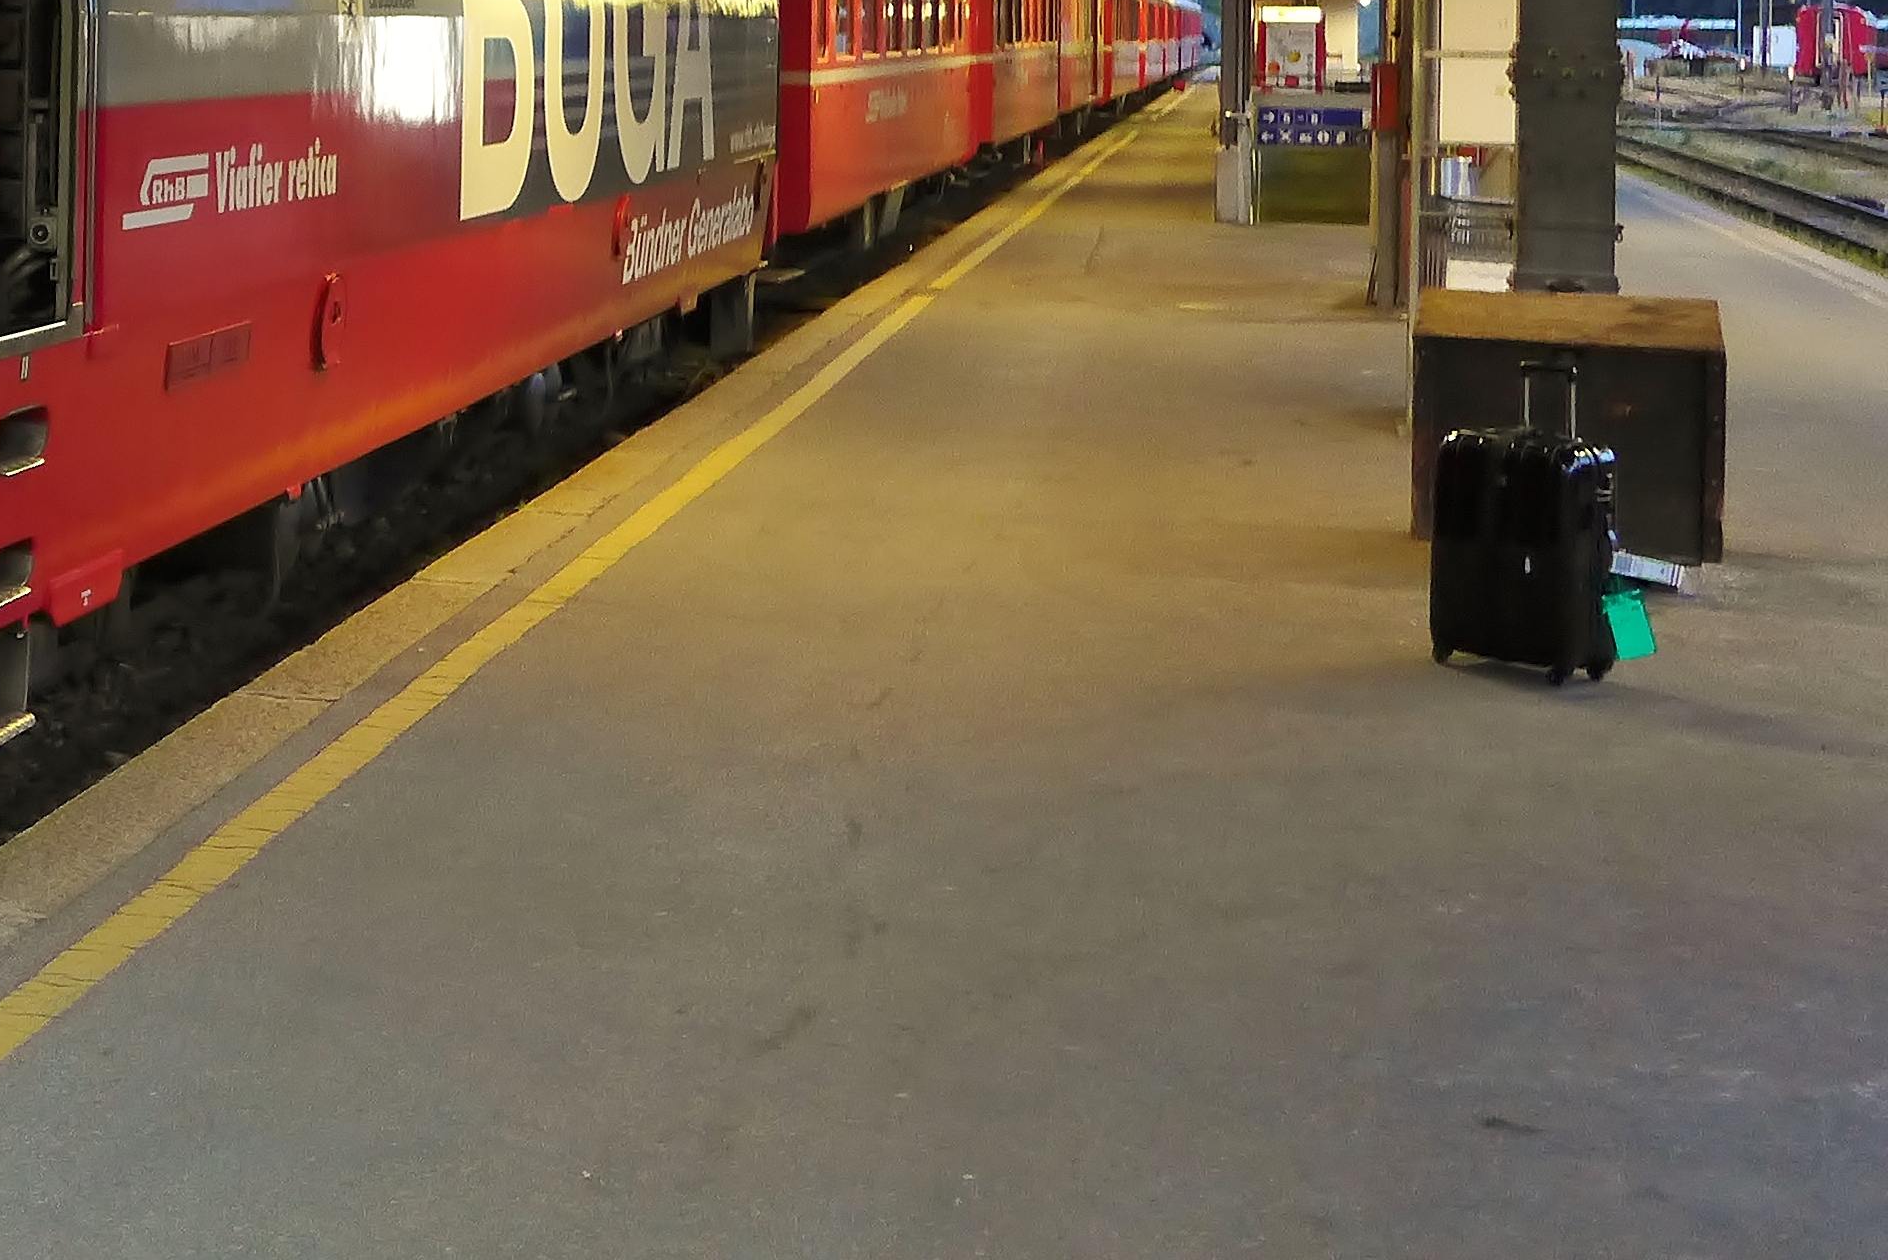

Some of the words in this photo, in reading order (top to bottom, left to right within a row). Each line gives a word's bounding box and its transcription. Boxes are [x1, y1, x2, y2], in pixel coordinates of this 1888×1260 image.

[152, 176, 186, 205] RhB
[215, 144, 283, 214] Viafier
[287, 136, 338, 202] retica
